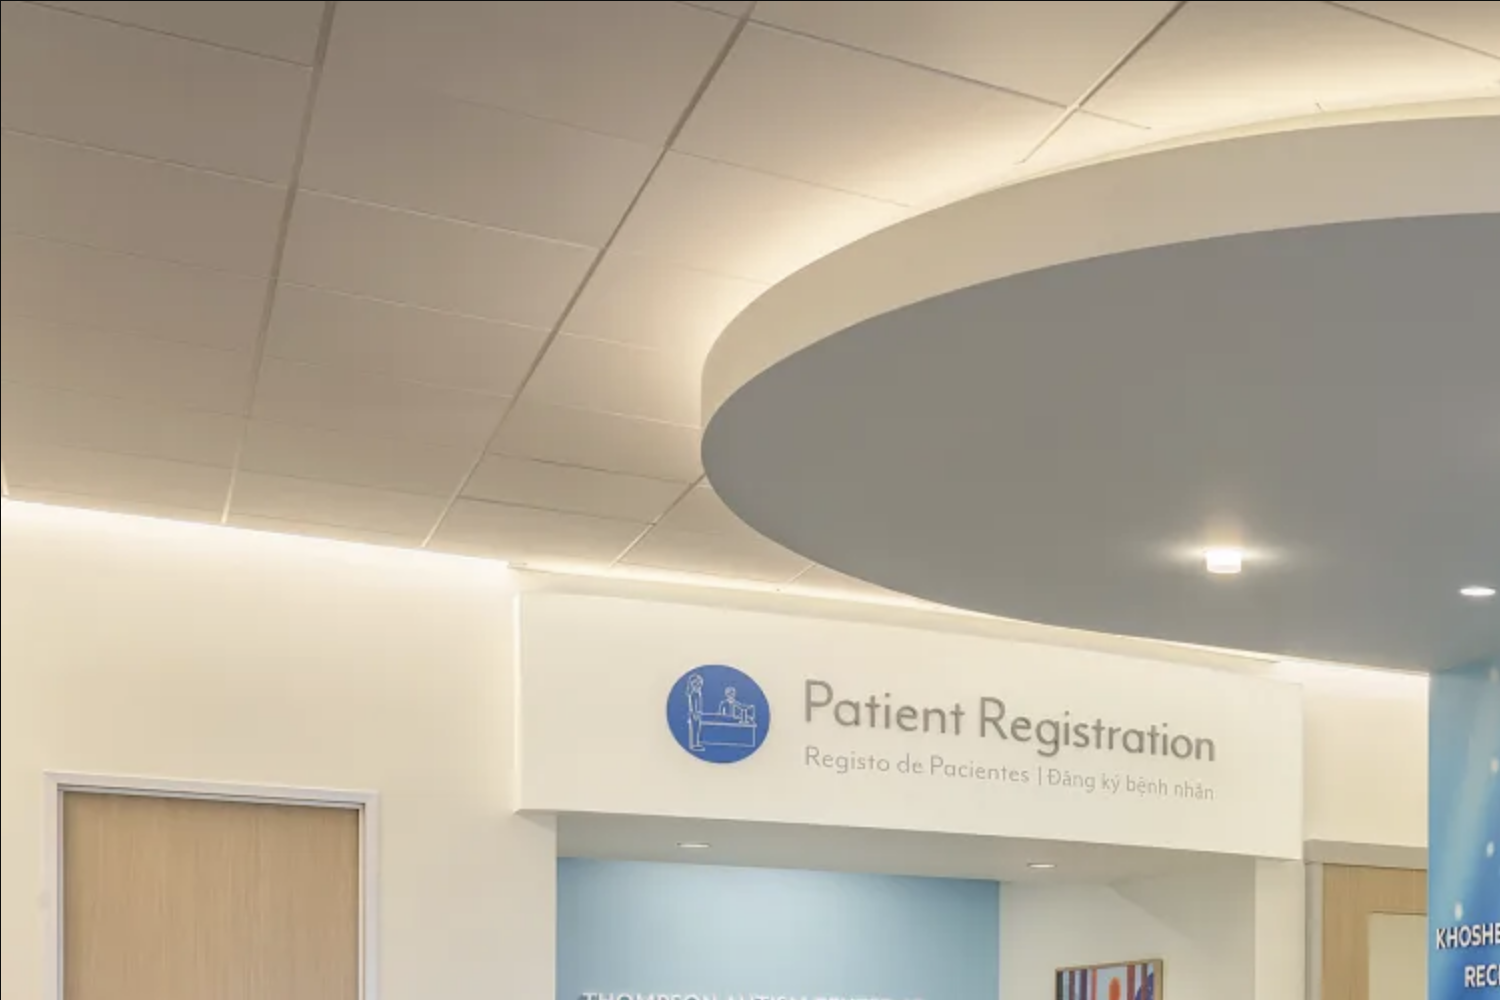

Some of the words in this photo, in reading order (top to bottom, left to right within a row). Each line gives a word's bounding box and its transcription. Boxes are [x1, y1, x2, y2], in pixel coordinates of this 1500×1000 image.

[804, 679, 966, 737] Patient
[979, 697, 1216, 761] Registration
[804, 745, 890, 774] Registo
[896, 753, 924, 774] de
[930, 755, 1030, 782] Pacientes
[1101, 773, 1121, 795] ký
